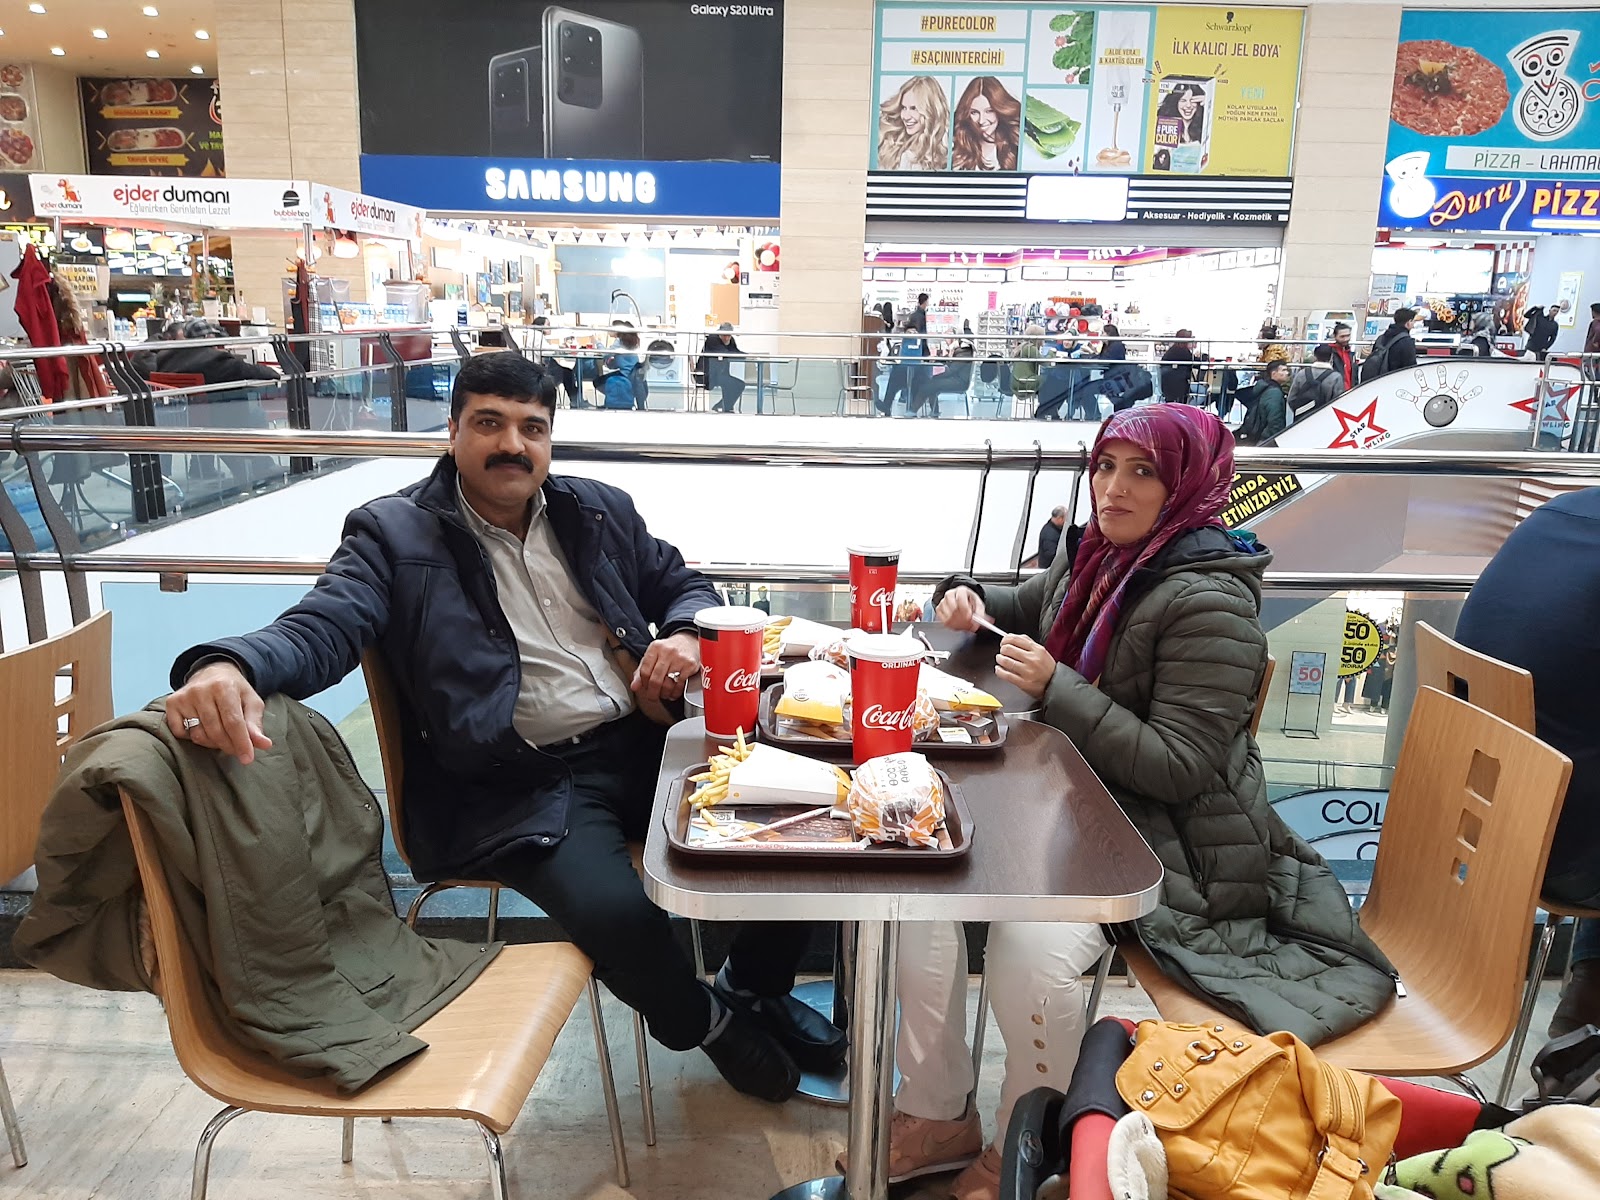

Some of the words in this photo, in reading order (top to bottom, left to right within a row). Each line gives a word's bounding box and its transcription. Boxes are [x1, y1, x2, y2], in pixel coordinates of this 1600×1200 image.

[691, 4, 729, 17] Galaxy
[730, 5, 748, 15] S20
[749, 6, 774, 16] Ultra
[921, 16, 994, 31] #PURECOLOR
[1206, 22, 1252, 34] Schwarzkopf
[1173, 37, 1189, 55] İLK
[1194, 42, 1227, 56] KALICI
[1231, 43, 1249, 57] JEL
[913, 48, 1001, 66] #SAÇININTERCİHİ
[1156, 134, 1178, 144] COLOR
[1474, 150, 1521, 168] PİZZA
[485, 167, 656, 203] SAMSUNG
[114, 184, 159, 205] ejder
[163, 185, 230, 204] dumanı
[1429, 181, 1513, 226] Duru
[209, 204, 231, 216] Lezzet
[351, 198, 369, 220] ejder
[1143, 211, 1181, 220] Aksesuar
[1188, 211, 1226, 222] Hediyelik
[1233, 212, 1272, 221] Kozmetik
[1350, 422, 1366, 439] STAR
[1543, 421, 1570, 429] WLING
[1218, 474, 1297, 527] ETİNİZDEYİZ
[1344, 622, 1370, 640] 50
[1341, 646, 1366, 664] 50
[1298, 667, 1321, 682] 50
